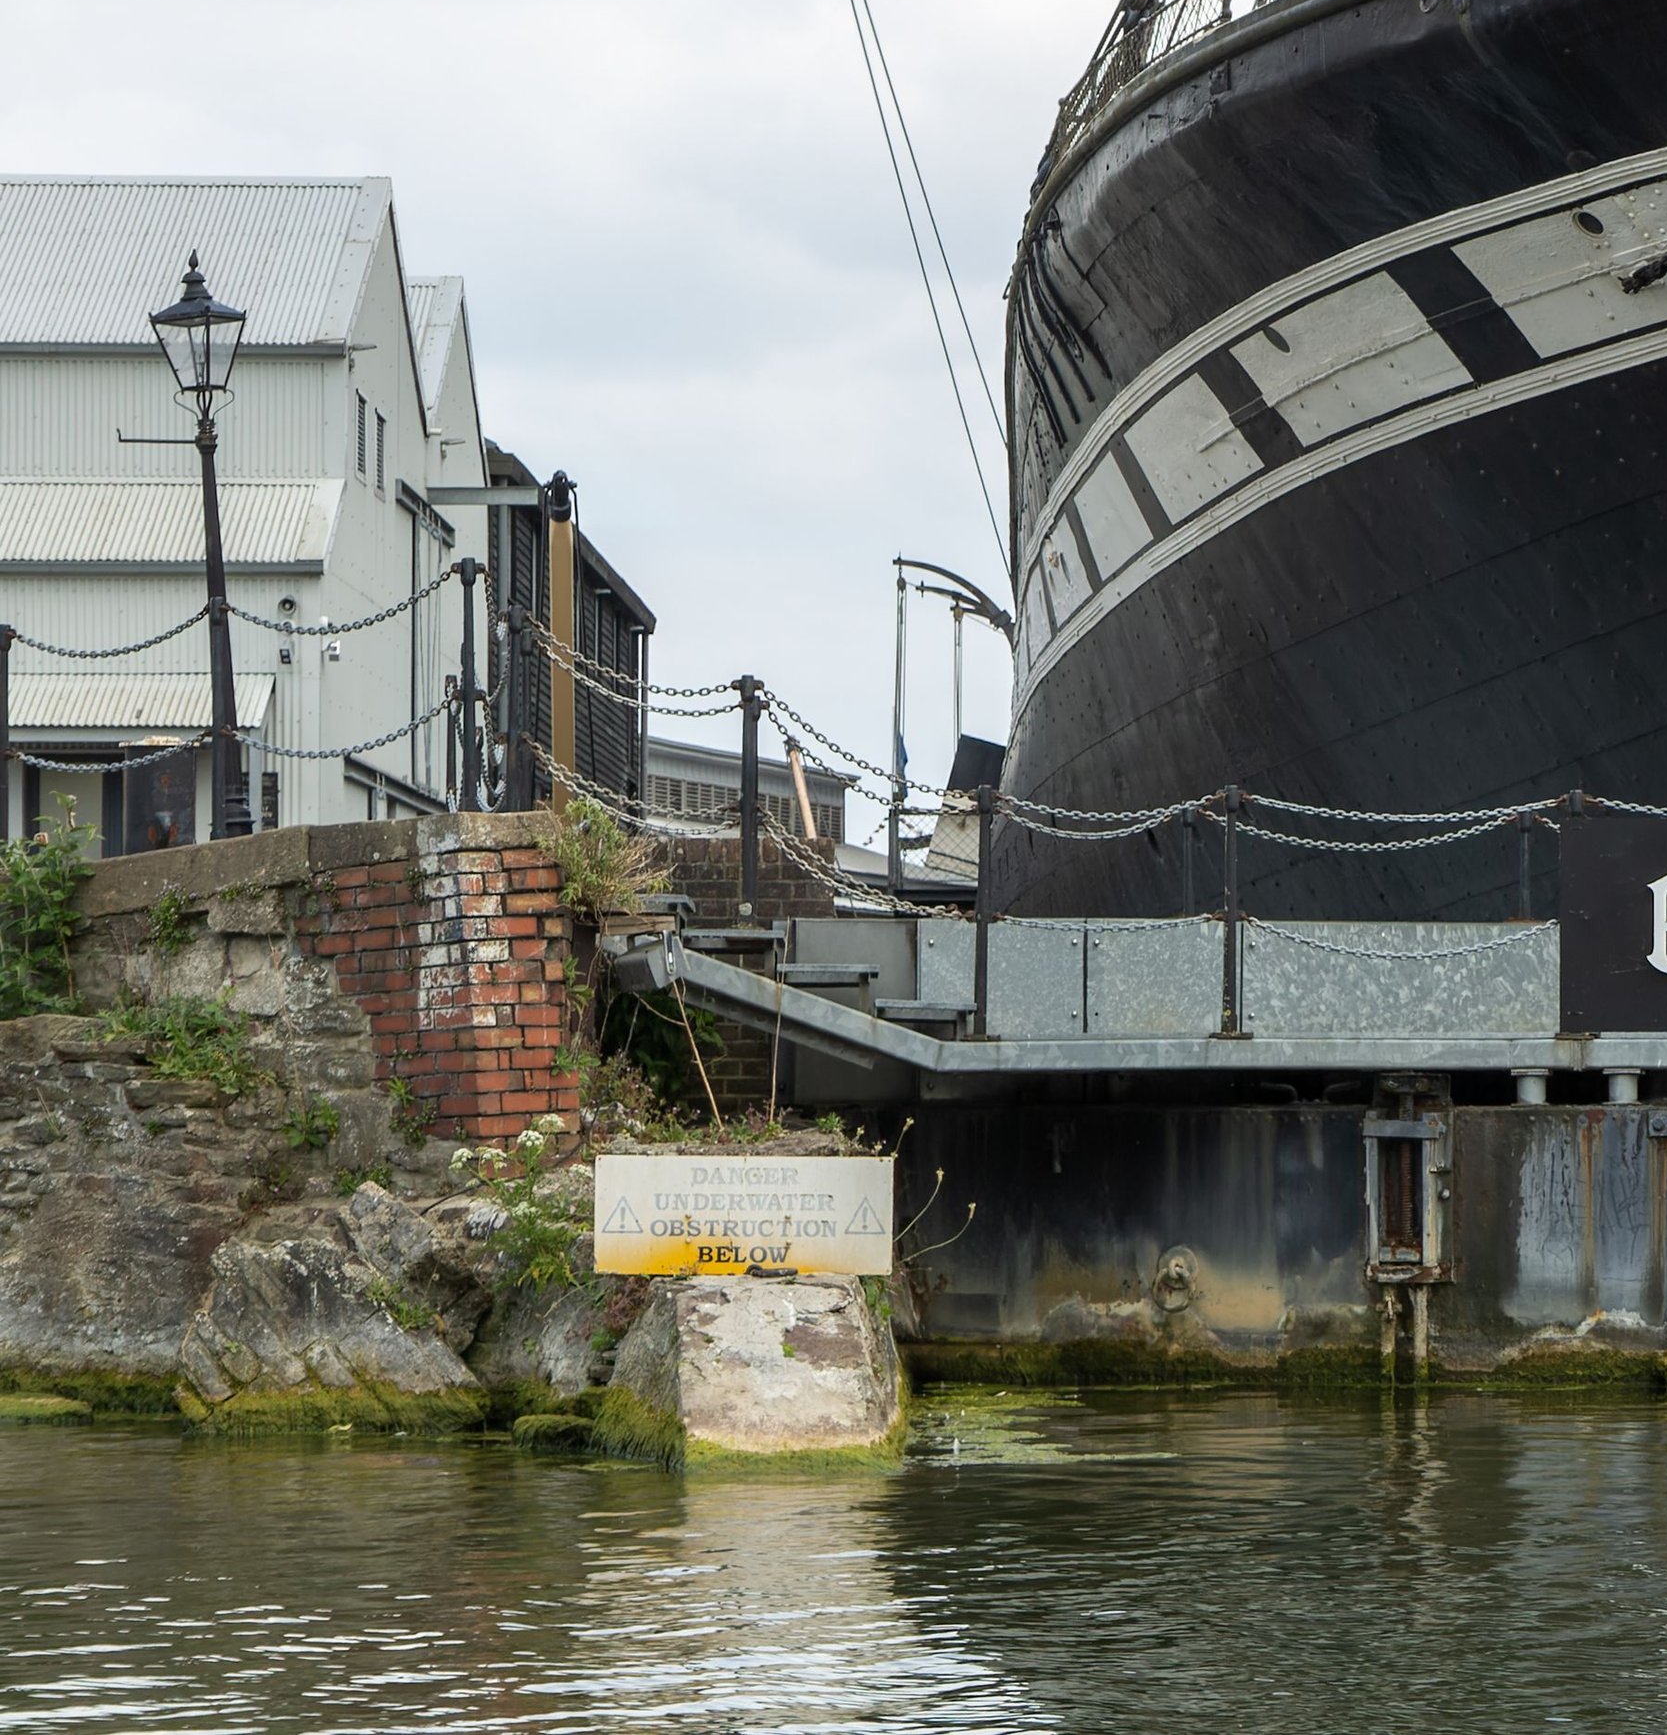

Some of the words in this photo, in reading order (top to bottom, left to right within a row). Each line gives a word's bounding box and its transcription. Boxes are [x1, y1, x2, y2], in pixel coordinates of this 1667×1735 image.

[690, 1167, 799, 1186] DANGER
[653, 1193, 836, 1212] UNDERWATER
[649, 1219, 838, 1238] OBSTRUCTION
[698, 1245, 789, 1264] BELOW
